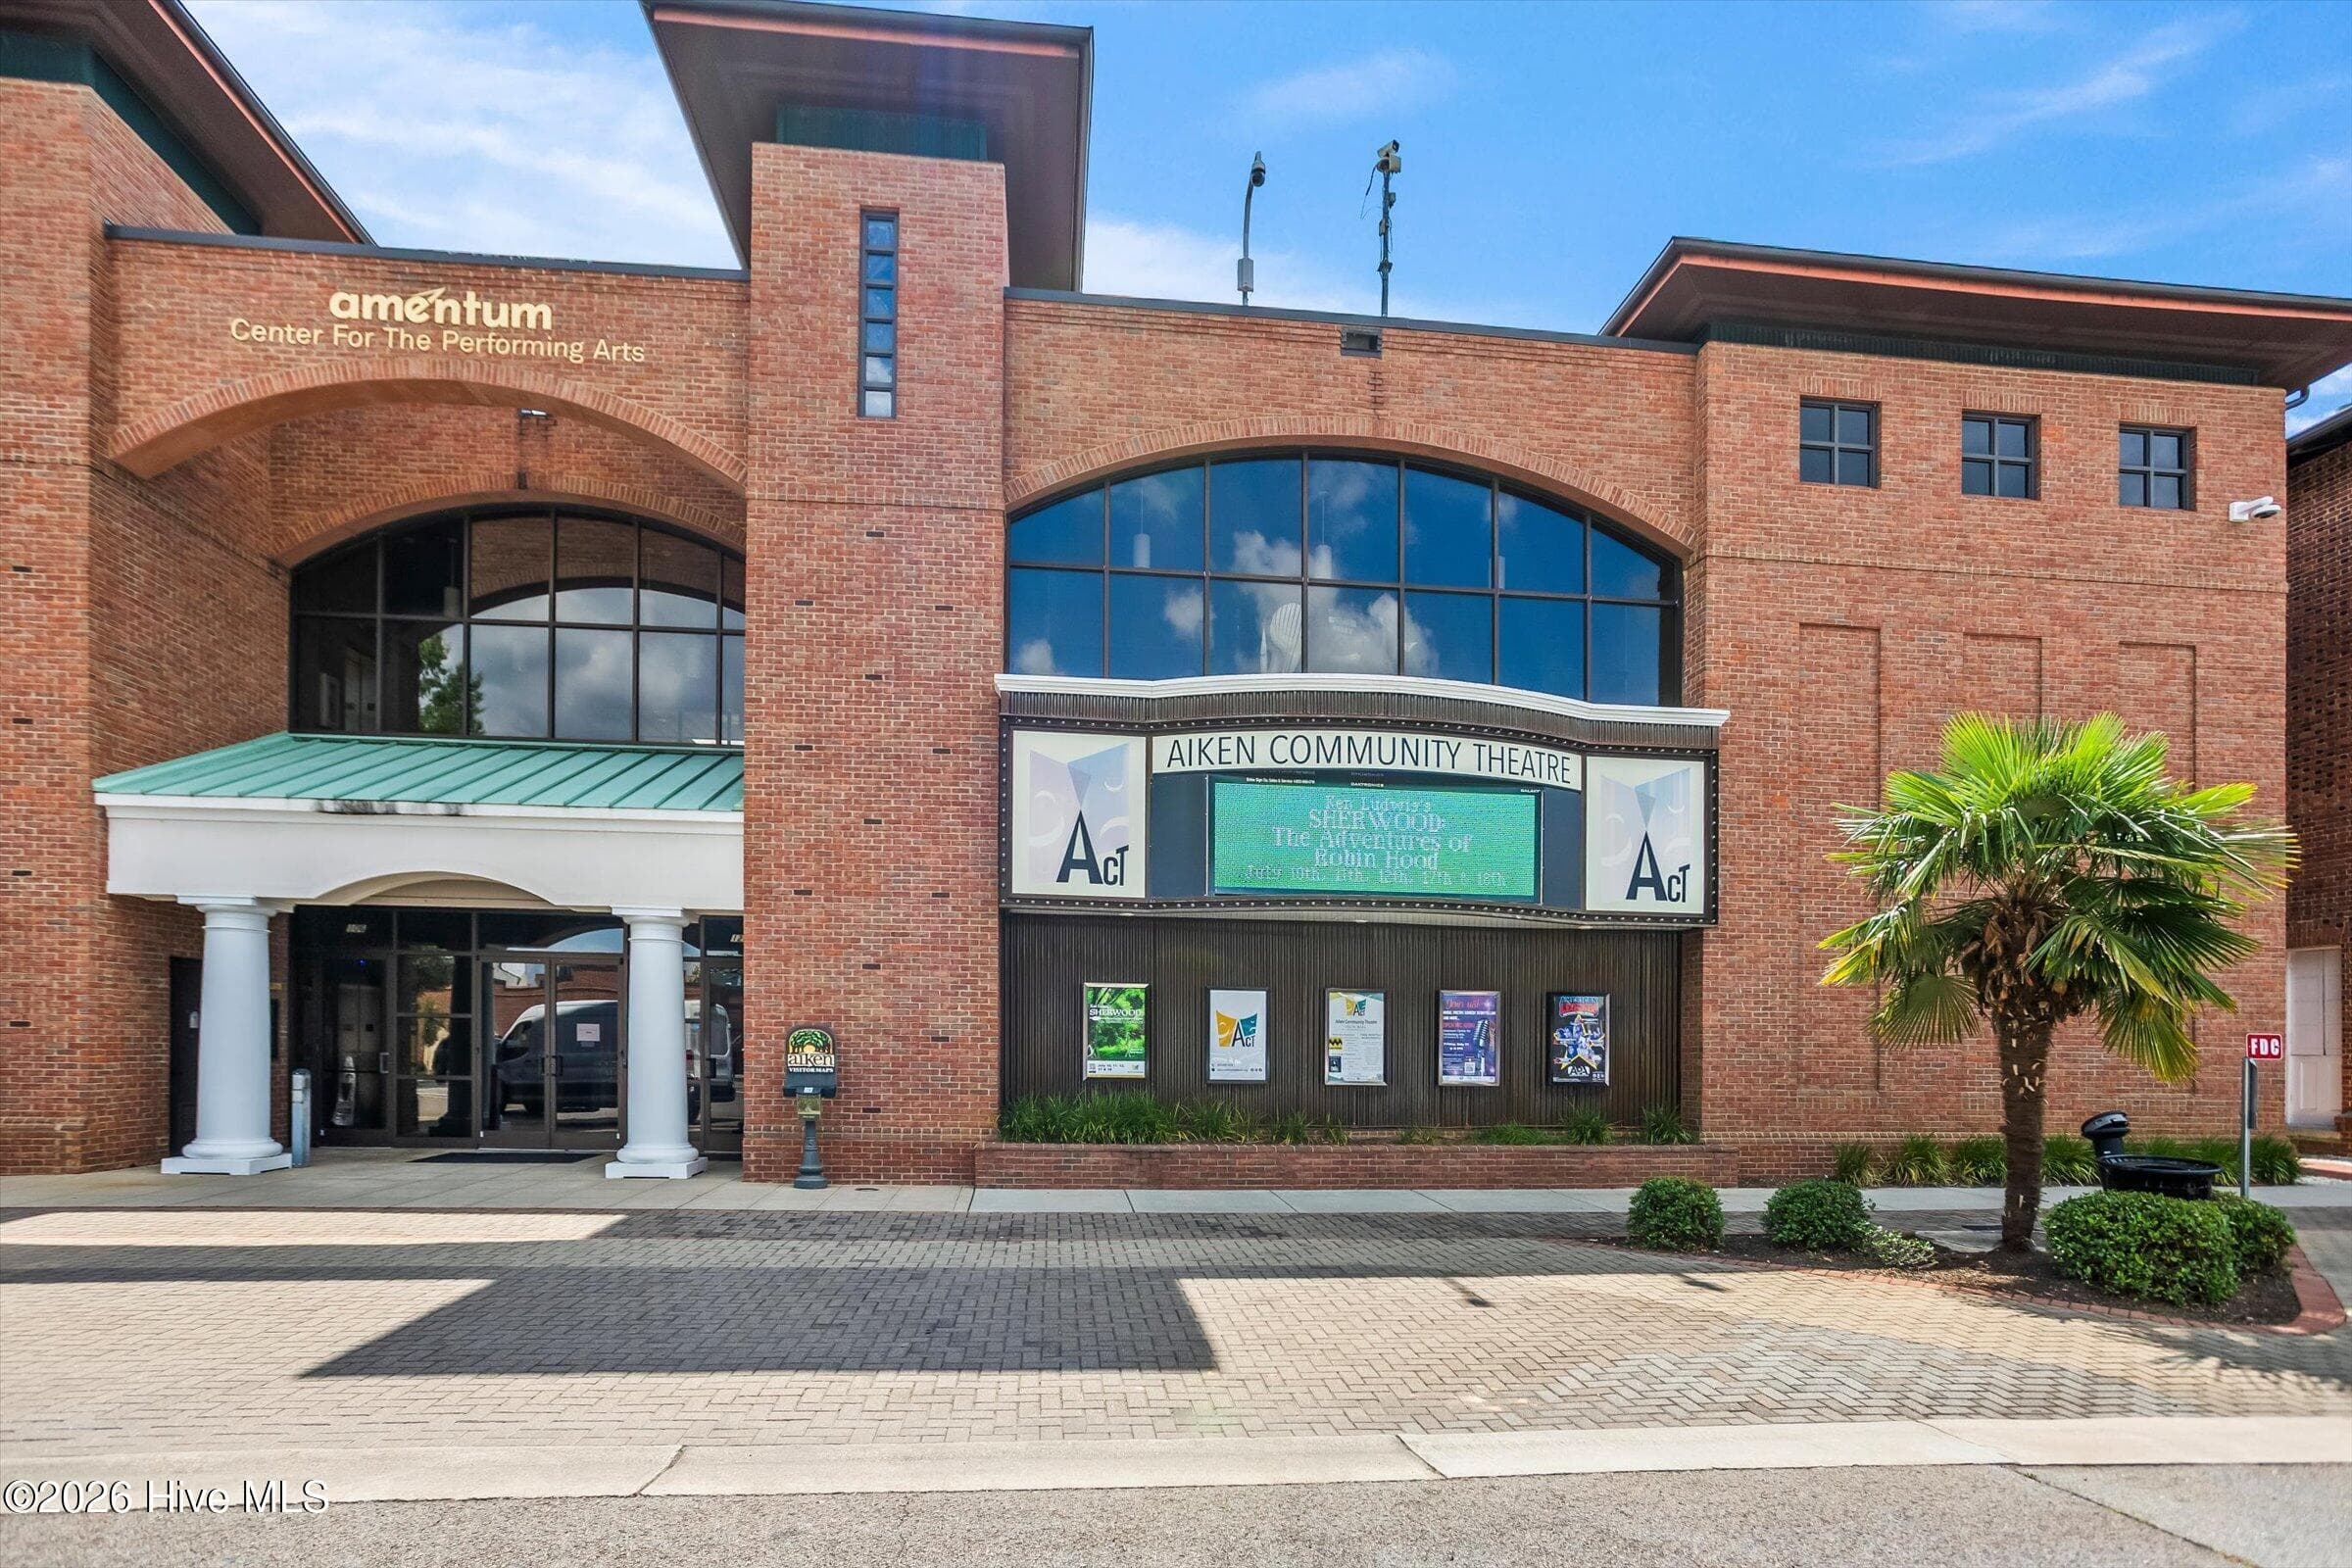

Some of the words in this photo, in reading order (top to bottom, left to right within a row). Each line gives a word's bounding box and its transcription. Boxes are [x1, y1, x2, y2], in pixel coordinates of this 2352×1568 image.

[329, 287, 553, 330] amentum
[230, 318, 322, 345] Center
[333, 325, 374, 348] For
[384, 327, 431, 351] The
[443, 330, 584, 365] Performing
[593, 339, 645, 362] Arts
[1167, 736, 1255, 767] AIKEN
[1269, 735, 1461, 769] COMMUNITY
[1473, 743, 1571, 784] THEATRE
[1326, 795, 1352, 810] Ken
[1308, 808, 1446, 832] SHERWOOD
[1273, 827, 1310, 847] The
[1320, 830, 1441, 852] Adventures
[1448, 835, 1473, 852] of
[1314, 848, 1376, 869] Robin
[1386, 851, 1439, 871] Hood
[1089, 1008, 1142, 1017] SHERWOOD
[2250, 1038, 2279, 1055] FDC
[788, 1054, 834, 1067] aiken
